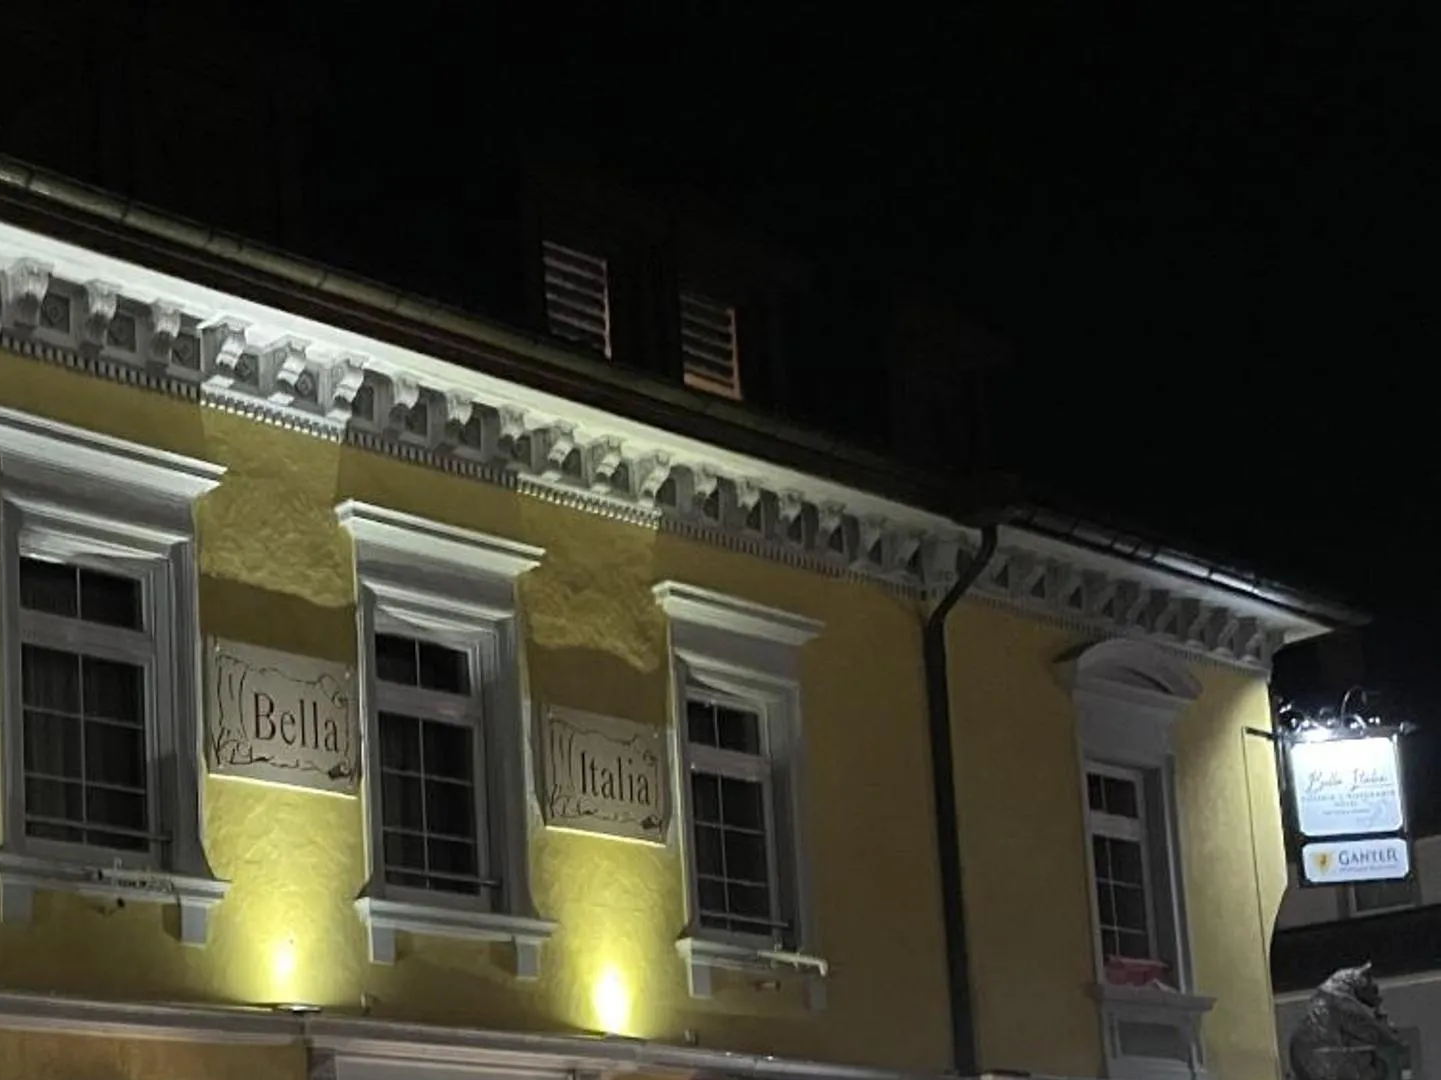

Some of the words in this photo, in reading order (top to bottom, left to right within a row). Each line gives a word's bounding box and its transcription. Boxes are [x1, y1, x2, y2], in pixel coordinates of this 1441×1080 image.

[254, 691, 339, 754] Bella
[581, 750, 651, 806] Italia
[1338, 848, 1398, 866] GANTER
